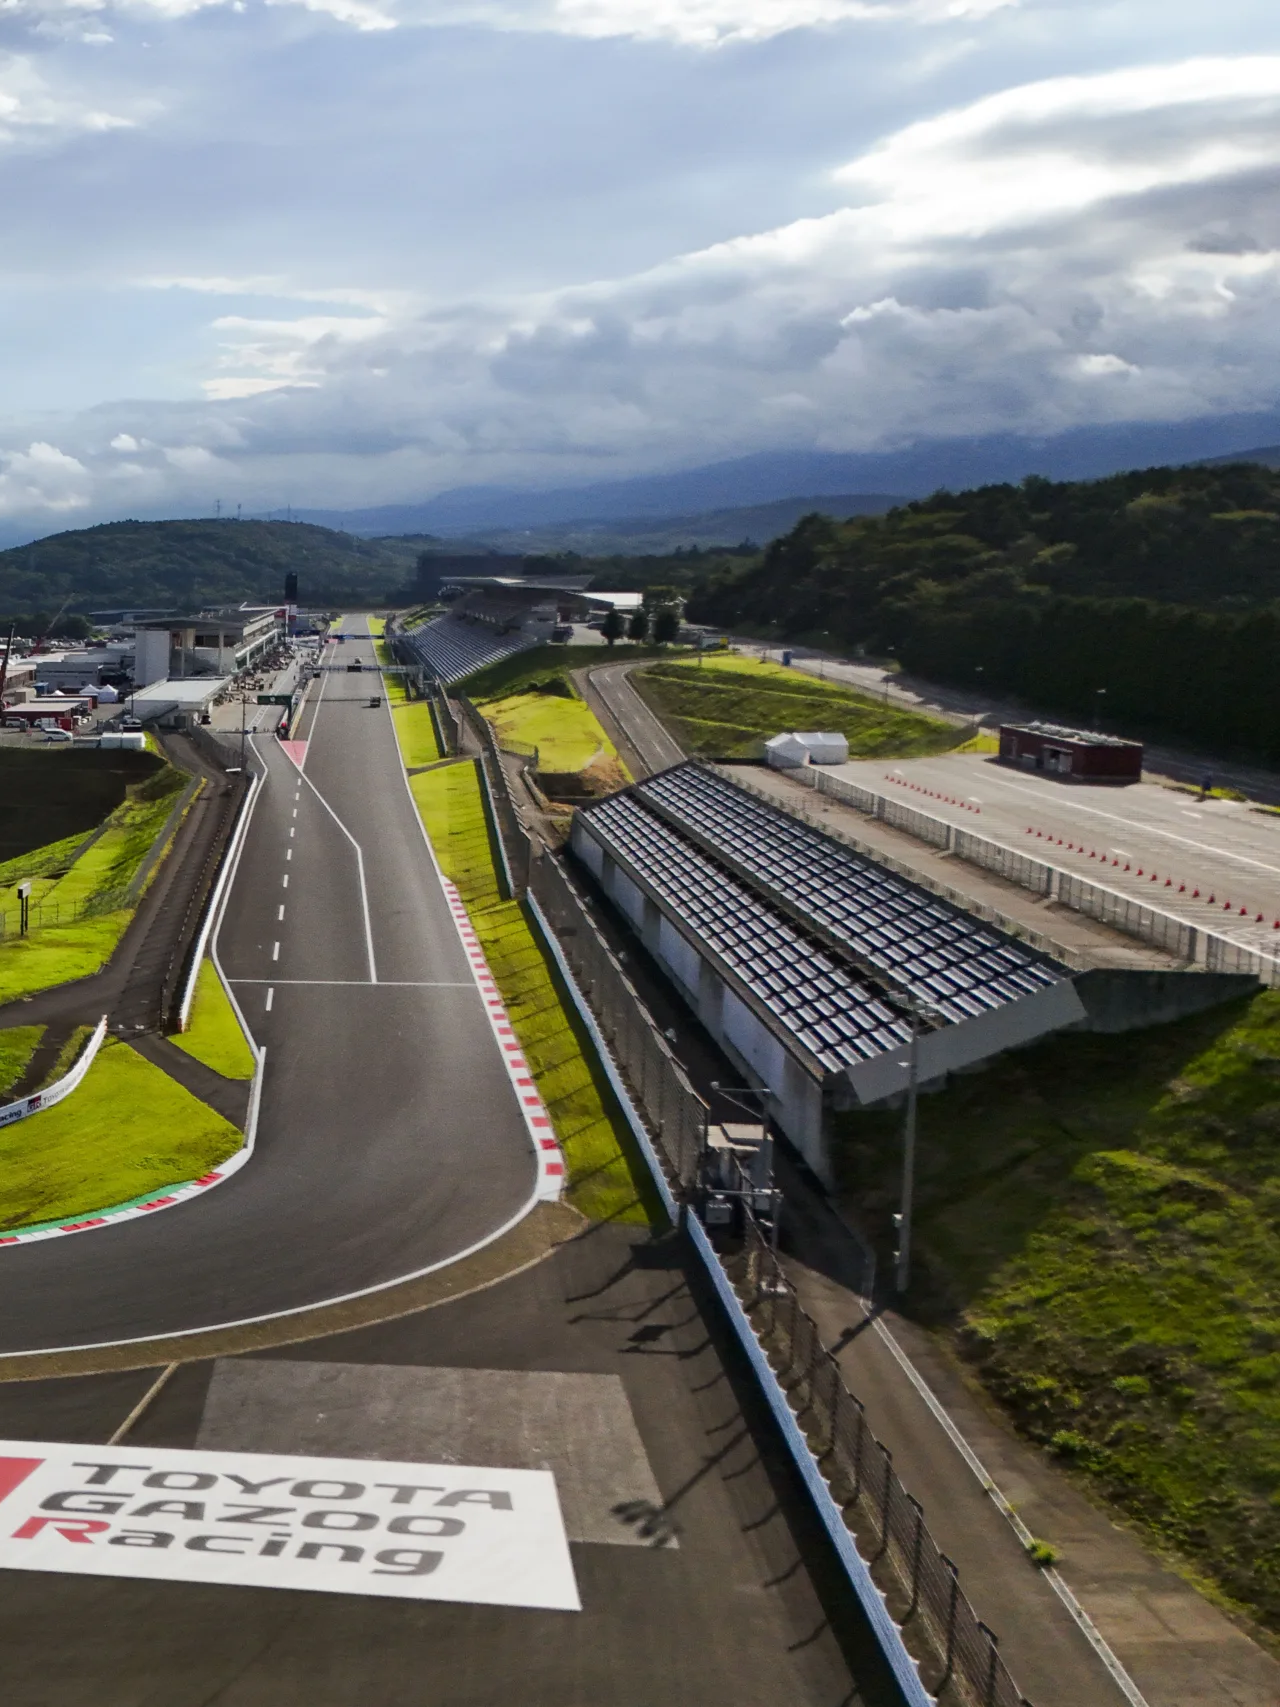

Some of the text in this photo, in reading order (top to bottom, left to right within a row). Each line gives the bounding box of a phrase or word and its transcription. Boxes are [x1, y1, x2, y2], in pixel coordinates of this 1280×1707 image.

[71, 1461, 514, 1511] TOYOTA
[39, 1490, 467, 1537] GAZOO
[11, 1516, 444, 1576] Racing
